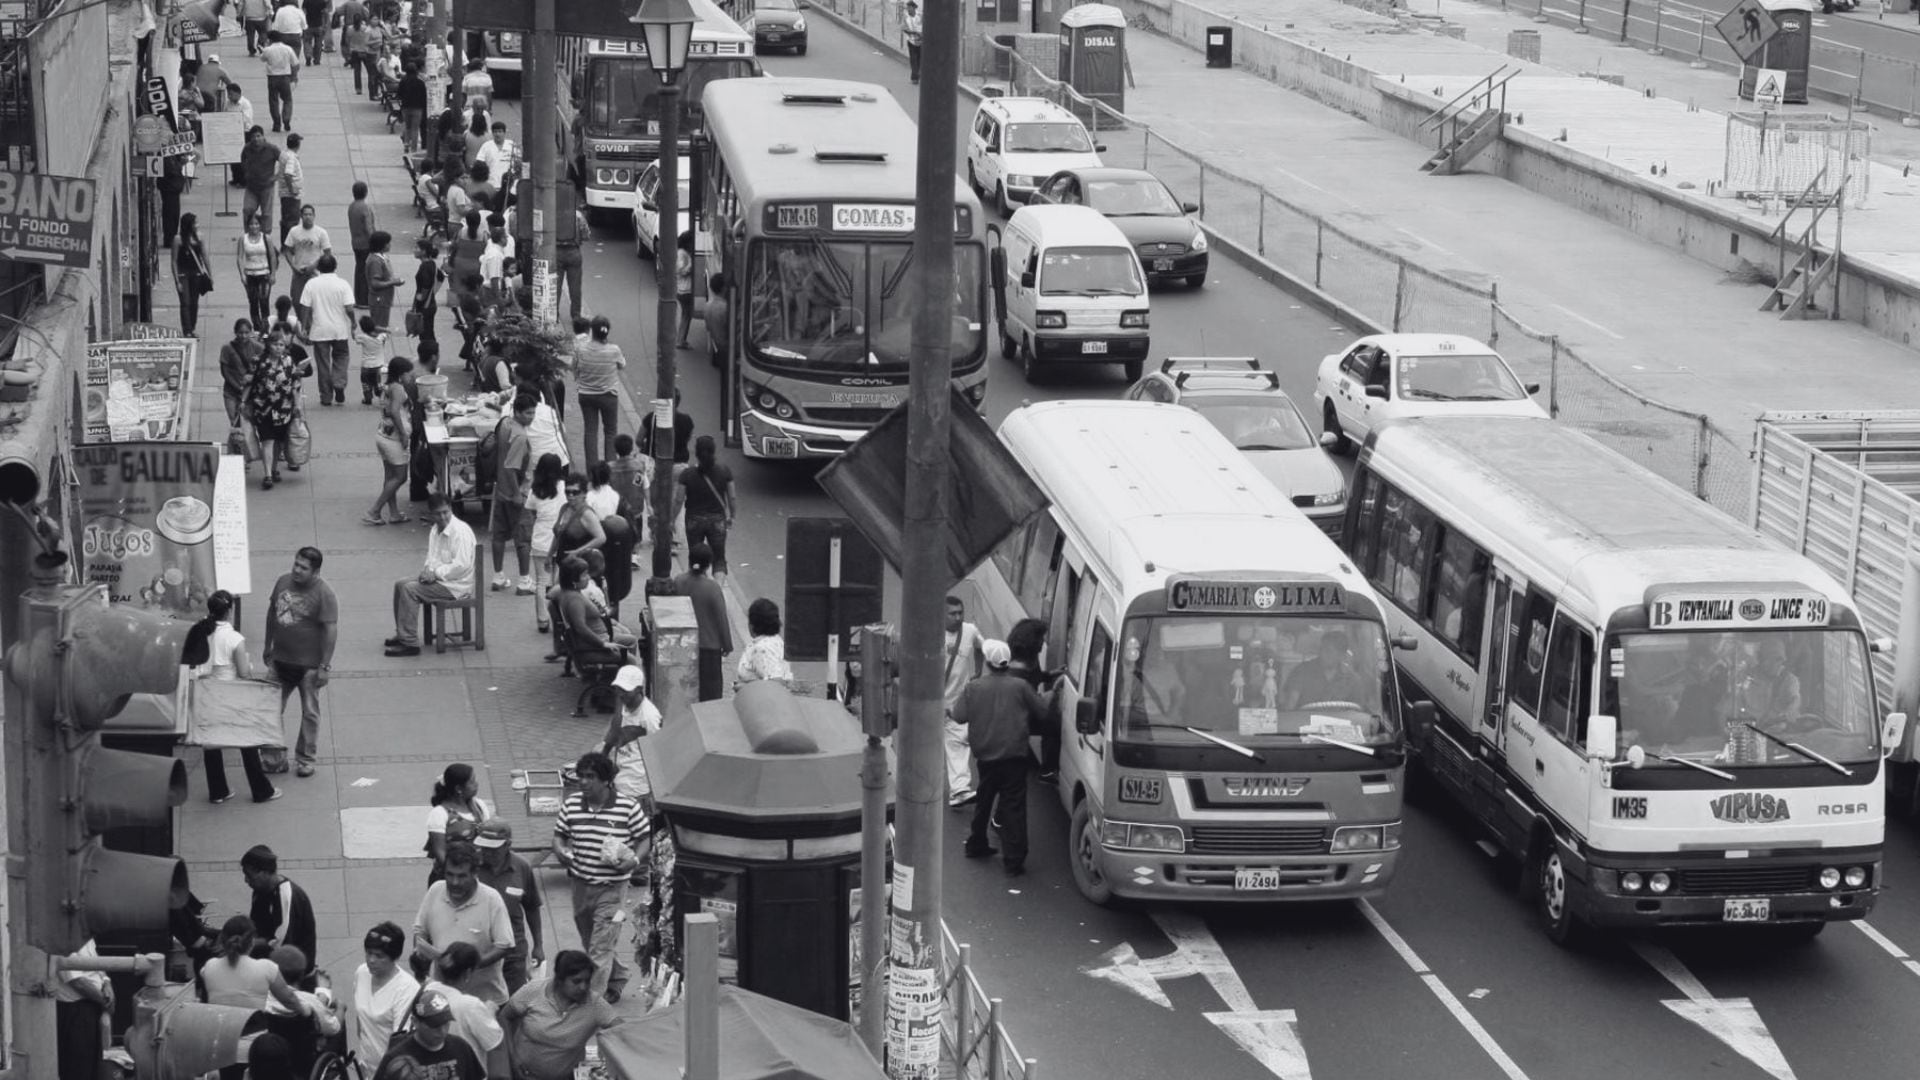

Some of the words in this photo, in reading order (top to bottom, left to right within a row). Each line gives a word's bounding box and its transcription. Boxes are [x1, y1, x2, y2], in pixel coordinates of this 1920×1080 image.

[1084, 36, 1116, 47] DISAL
[161, 143, 192, 157] FOTO
[595, 144, 629, 153] COVIDA
[19, 218, 69, 235] FONDO
[1, 231, 20, 245] LA
[26, 233, 90, 253] DERECHA
[120, 451, 214, 484] GALLINA
[84, 526, 153, 560] Jugos
[1281, 586, 1342, 606] LIMA
[1654, 601, 1673, 626] B
[1679, 600, 1734, 621] VENTANILLA
[1770, 598, 1804, 619] LINCE
[1807, 599, 1827, 624] 39
[1709, 792, 1790, 823] VIPUSA
[1818, 803, 1868, 815] ROSA
